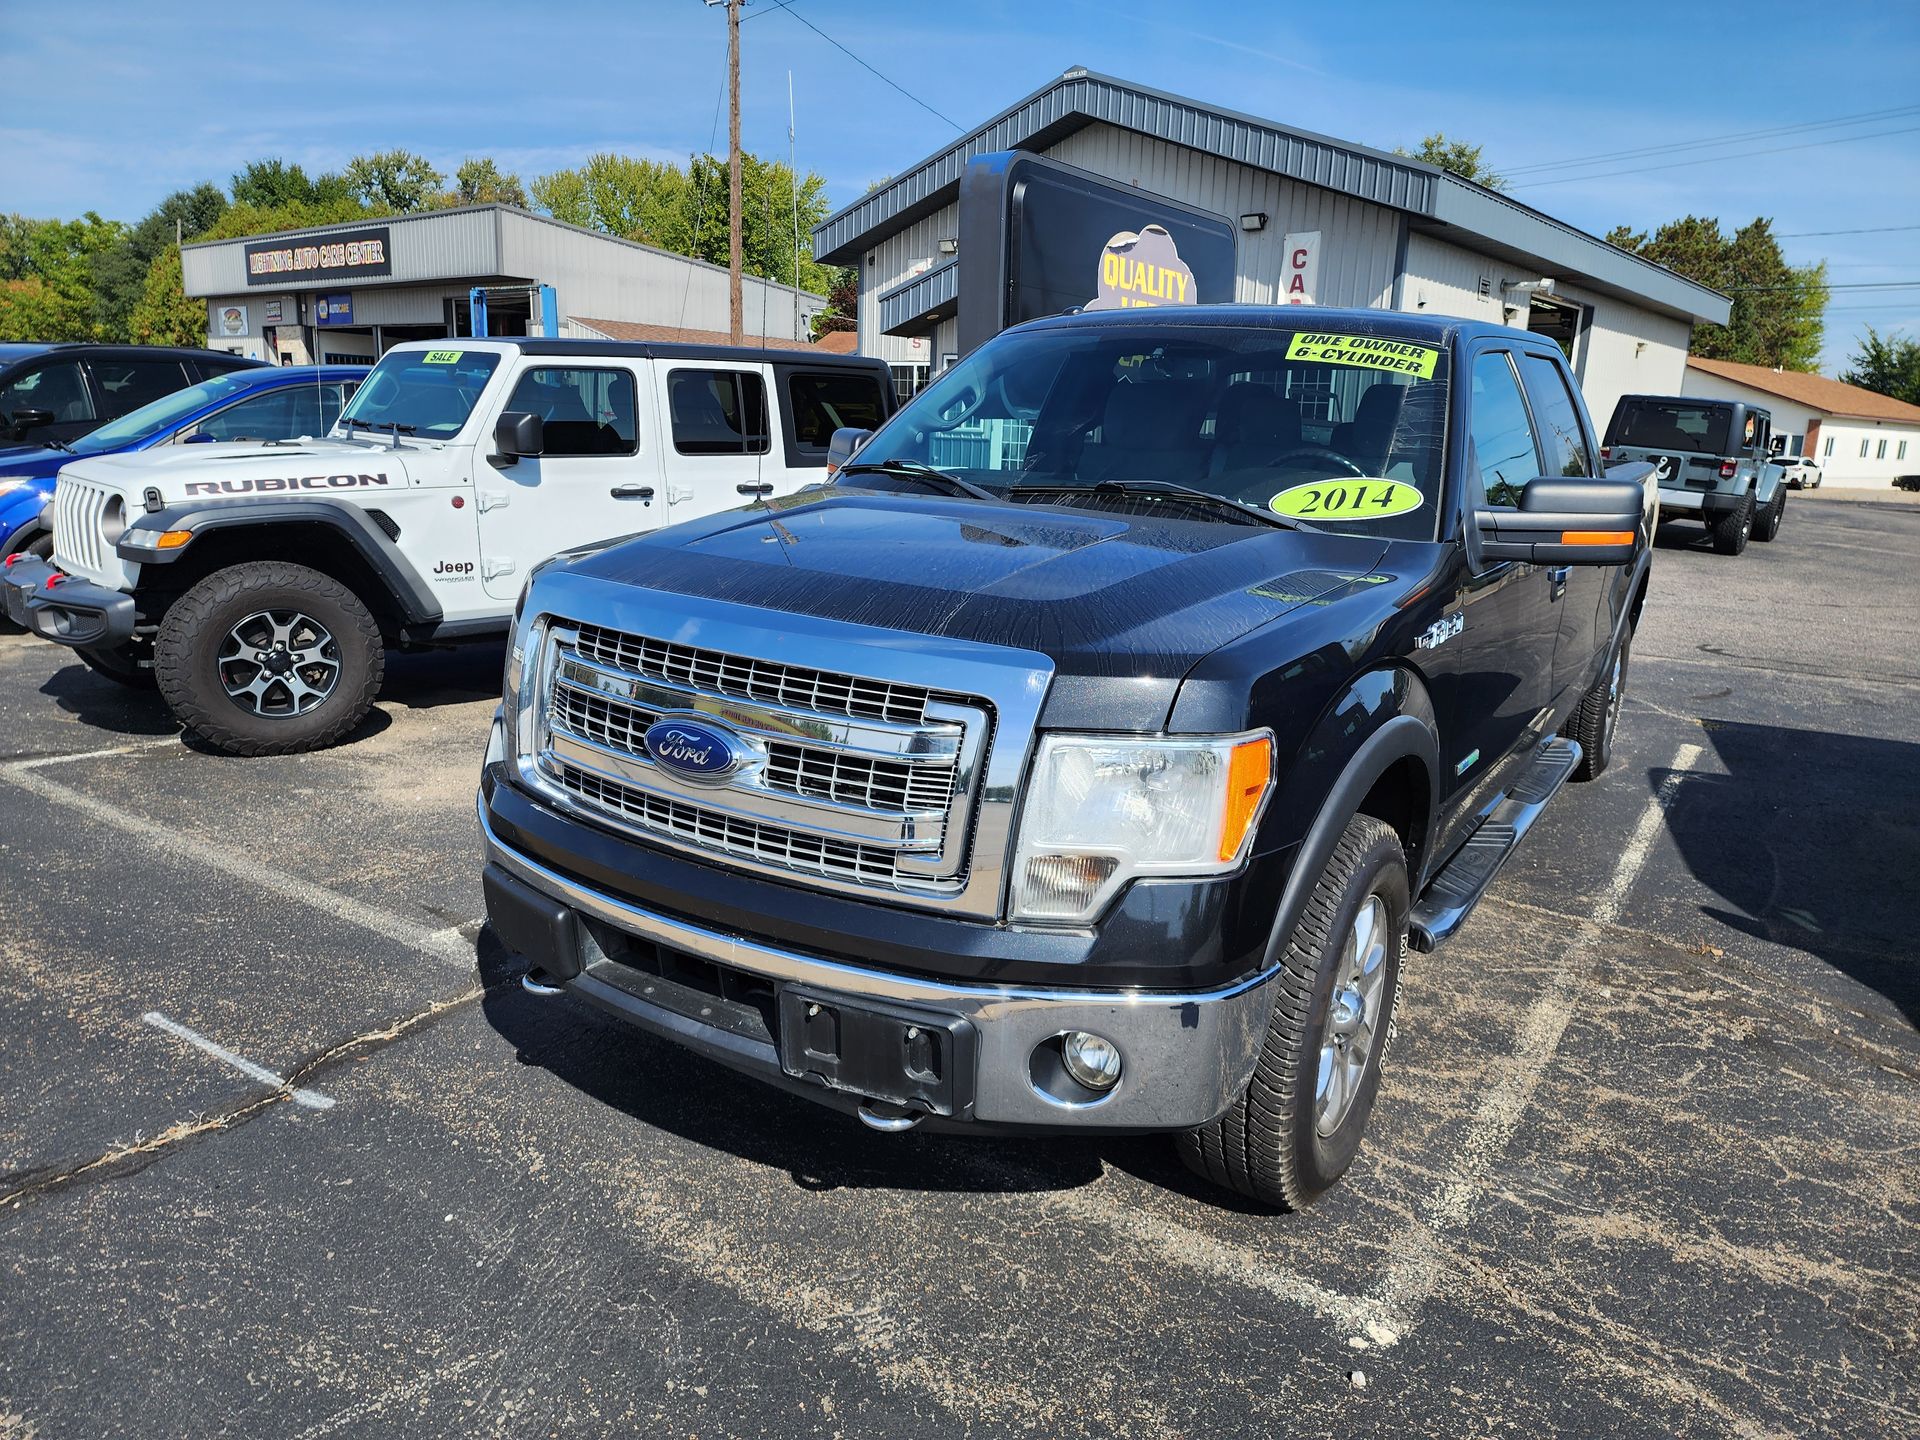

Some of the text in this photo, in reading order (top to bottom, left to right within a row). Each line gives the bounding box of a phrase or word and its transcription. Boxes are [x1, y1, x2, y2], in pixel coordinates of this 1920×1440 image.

[249, 239, 385, 274] LIGHTNING AUTO CARE CENTER
[1103, 253, 1188, 303] QUALITY
[430, 352, 456, 362] SALE
[1294, 347, 1424, 373] 6-CYLINDER
[1300, 334, 1427, 360] ONE OWNER
[185, 473, 388, 496] RUBICON
[1298, 484, 1396, 514] 2014
[433, 560, 474, 575] Jeep
[659, 729, 712, 766] Ford
